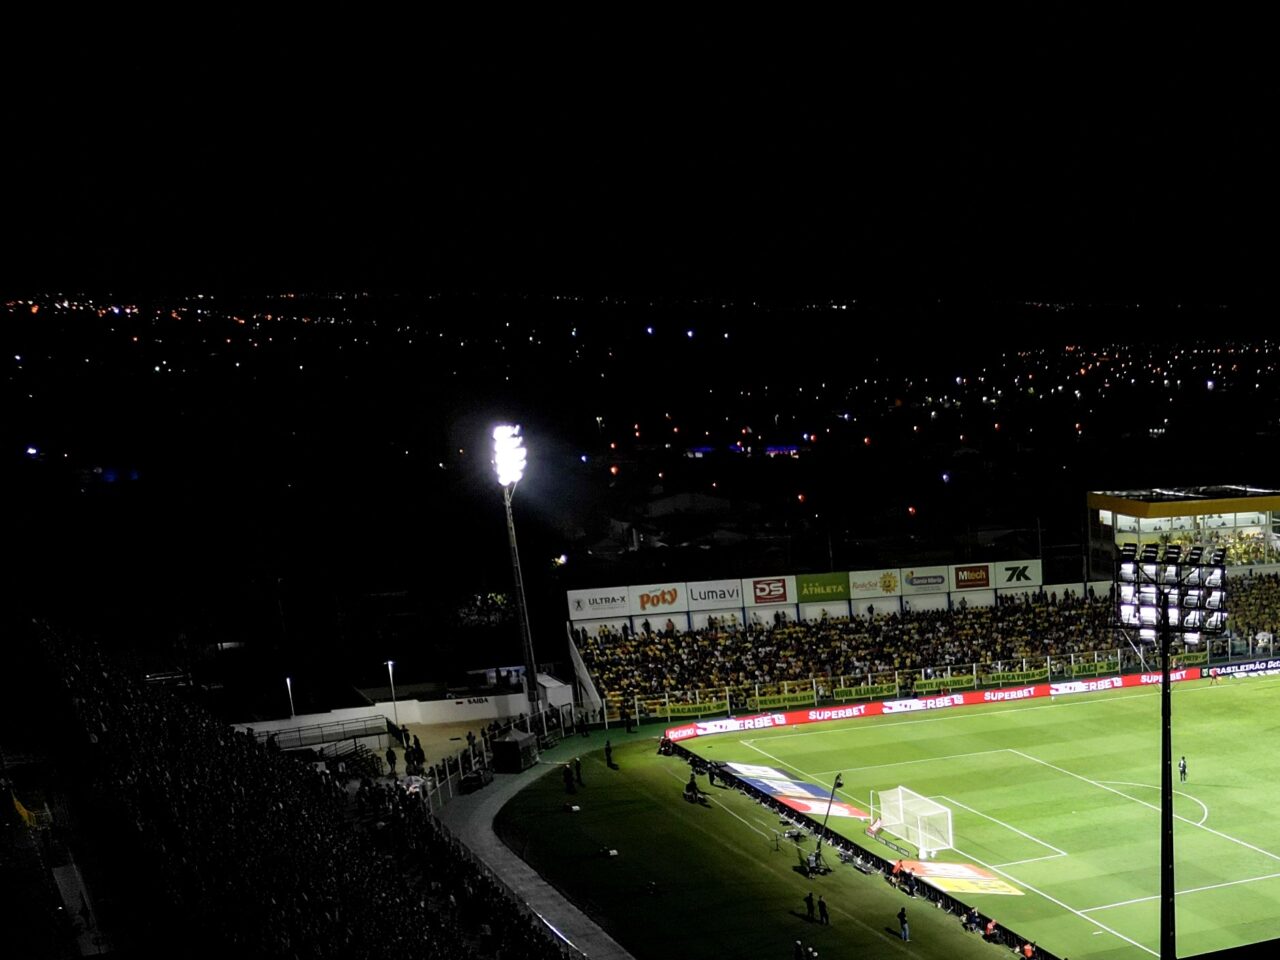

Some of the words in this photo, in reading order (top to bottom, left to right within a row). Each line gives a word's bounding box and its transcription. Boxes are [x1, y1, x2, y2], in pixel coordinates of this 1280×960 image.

[1004, 566, 1032, 582] 7K
[691, 587, 740, 601] Lumavi
[755, 582, 785, 597] DS
[588, 596, 626, 606] ULTRA-X
[638, 588, 678, 611] Poty
[1140, 671, 1187, 685] SUPEBET
[984, 686, 1036, 702] SUPERBET
[809, 704, 866, 720] SUPERBET
